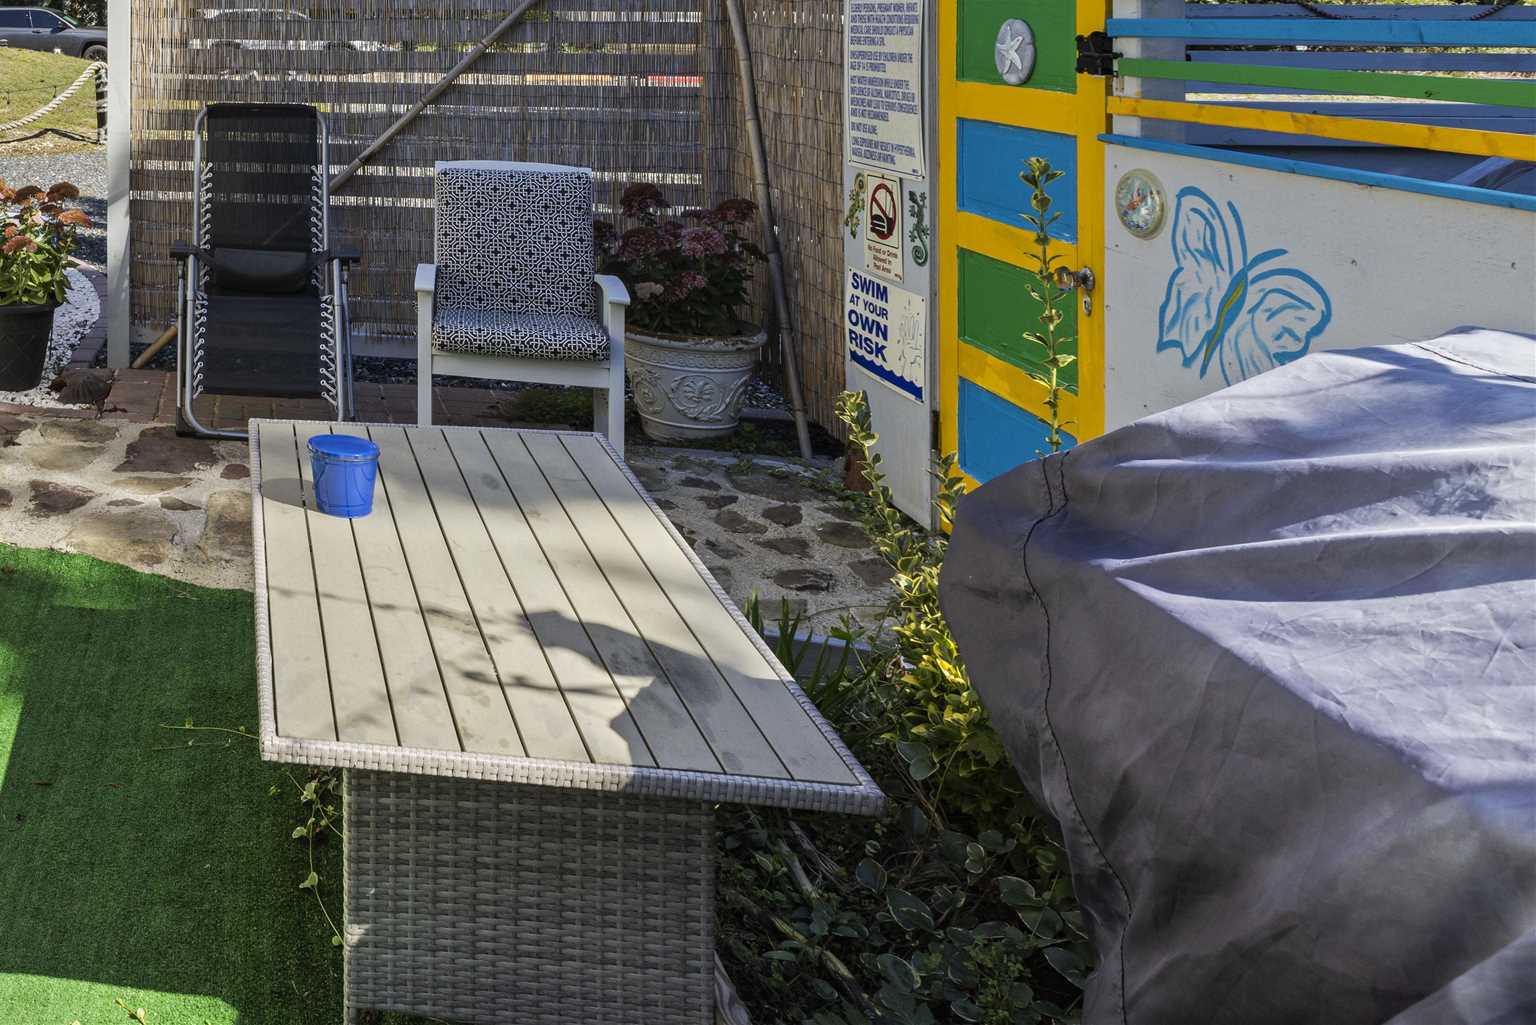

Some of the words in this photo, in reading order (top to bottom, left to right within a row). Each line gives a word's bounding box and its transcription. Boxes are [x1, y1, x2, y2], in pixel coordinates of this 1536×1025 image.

[851, 272, 889, 304] SWIM
[849, 293, 860, 306] AT
[863, 298, 889, 320] YOUR
[848, 309, 888, 342] OWN
[849, 328, 887, 363] RISK
